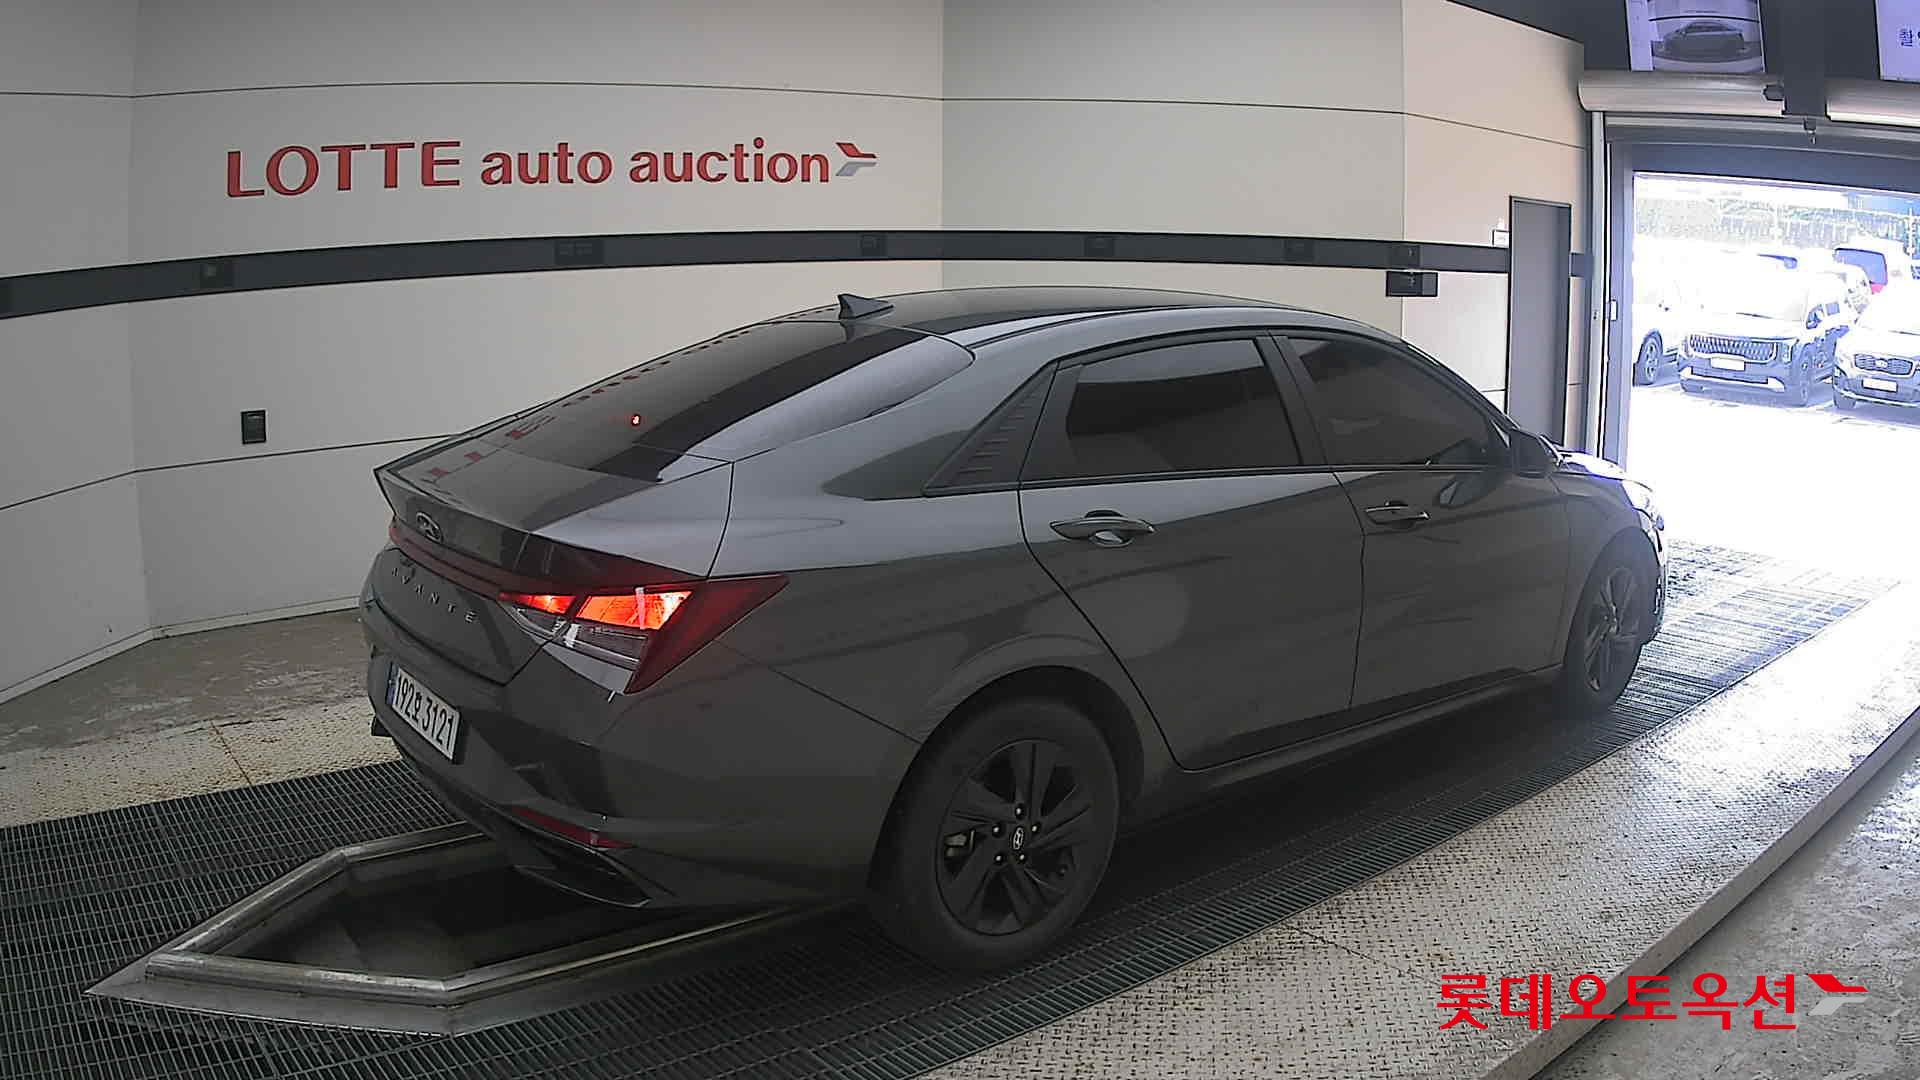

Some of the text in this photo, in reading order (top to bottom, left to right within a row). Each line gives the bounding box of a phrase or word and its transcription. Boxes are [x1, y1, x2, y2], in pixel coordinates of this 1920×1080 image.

[226, 136, 830, 198] LOTTE auto auction
[391, 566, 478, 624] AVANTE
[421, 695, 456, 751] 3121
